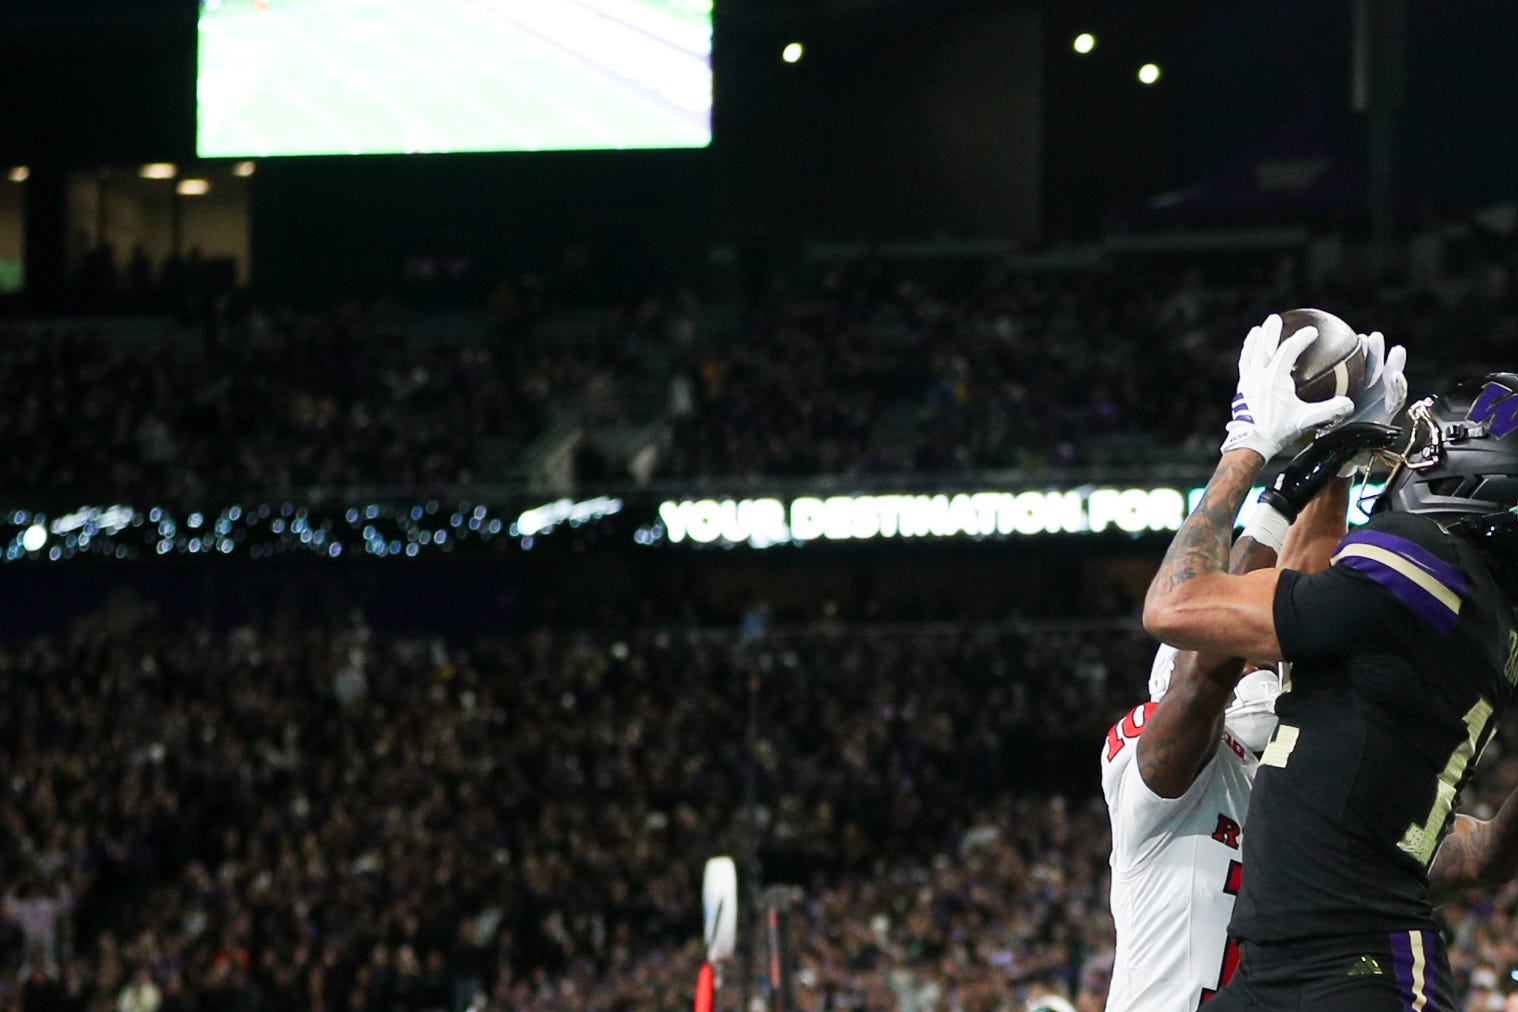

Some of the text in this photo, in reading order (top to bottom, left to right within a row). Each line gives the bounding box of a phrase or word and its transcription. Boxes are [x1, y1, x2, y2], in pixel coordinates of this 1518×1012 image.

[659, 498, 787, 544] YOUR
[790, 491, 1084, 541] DESTINATION
[1088, 488, 1184, 532] FOR
